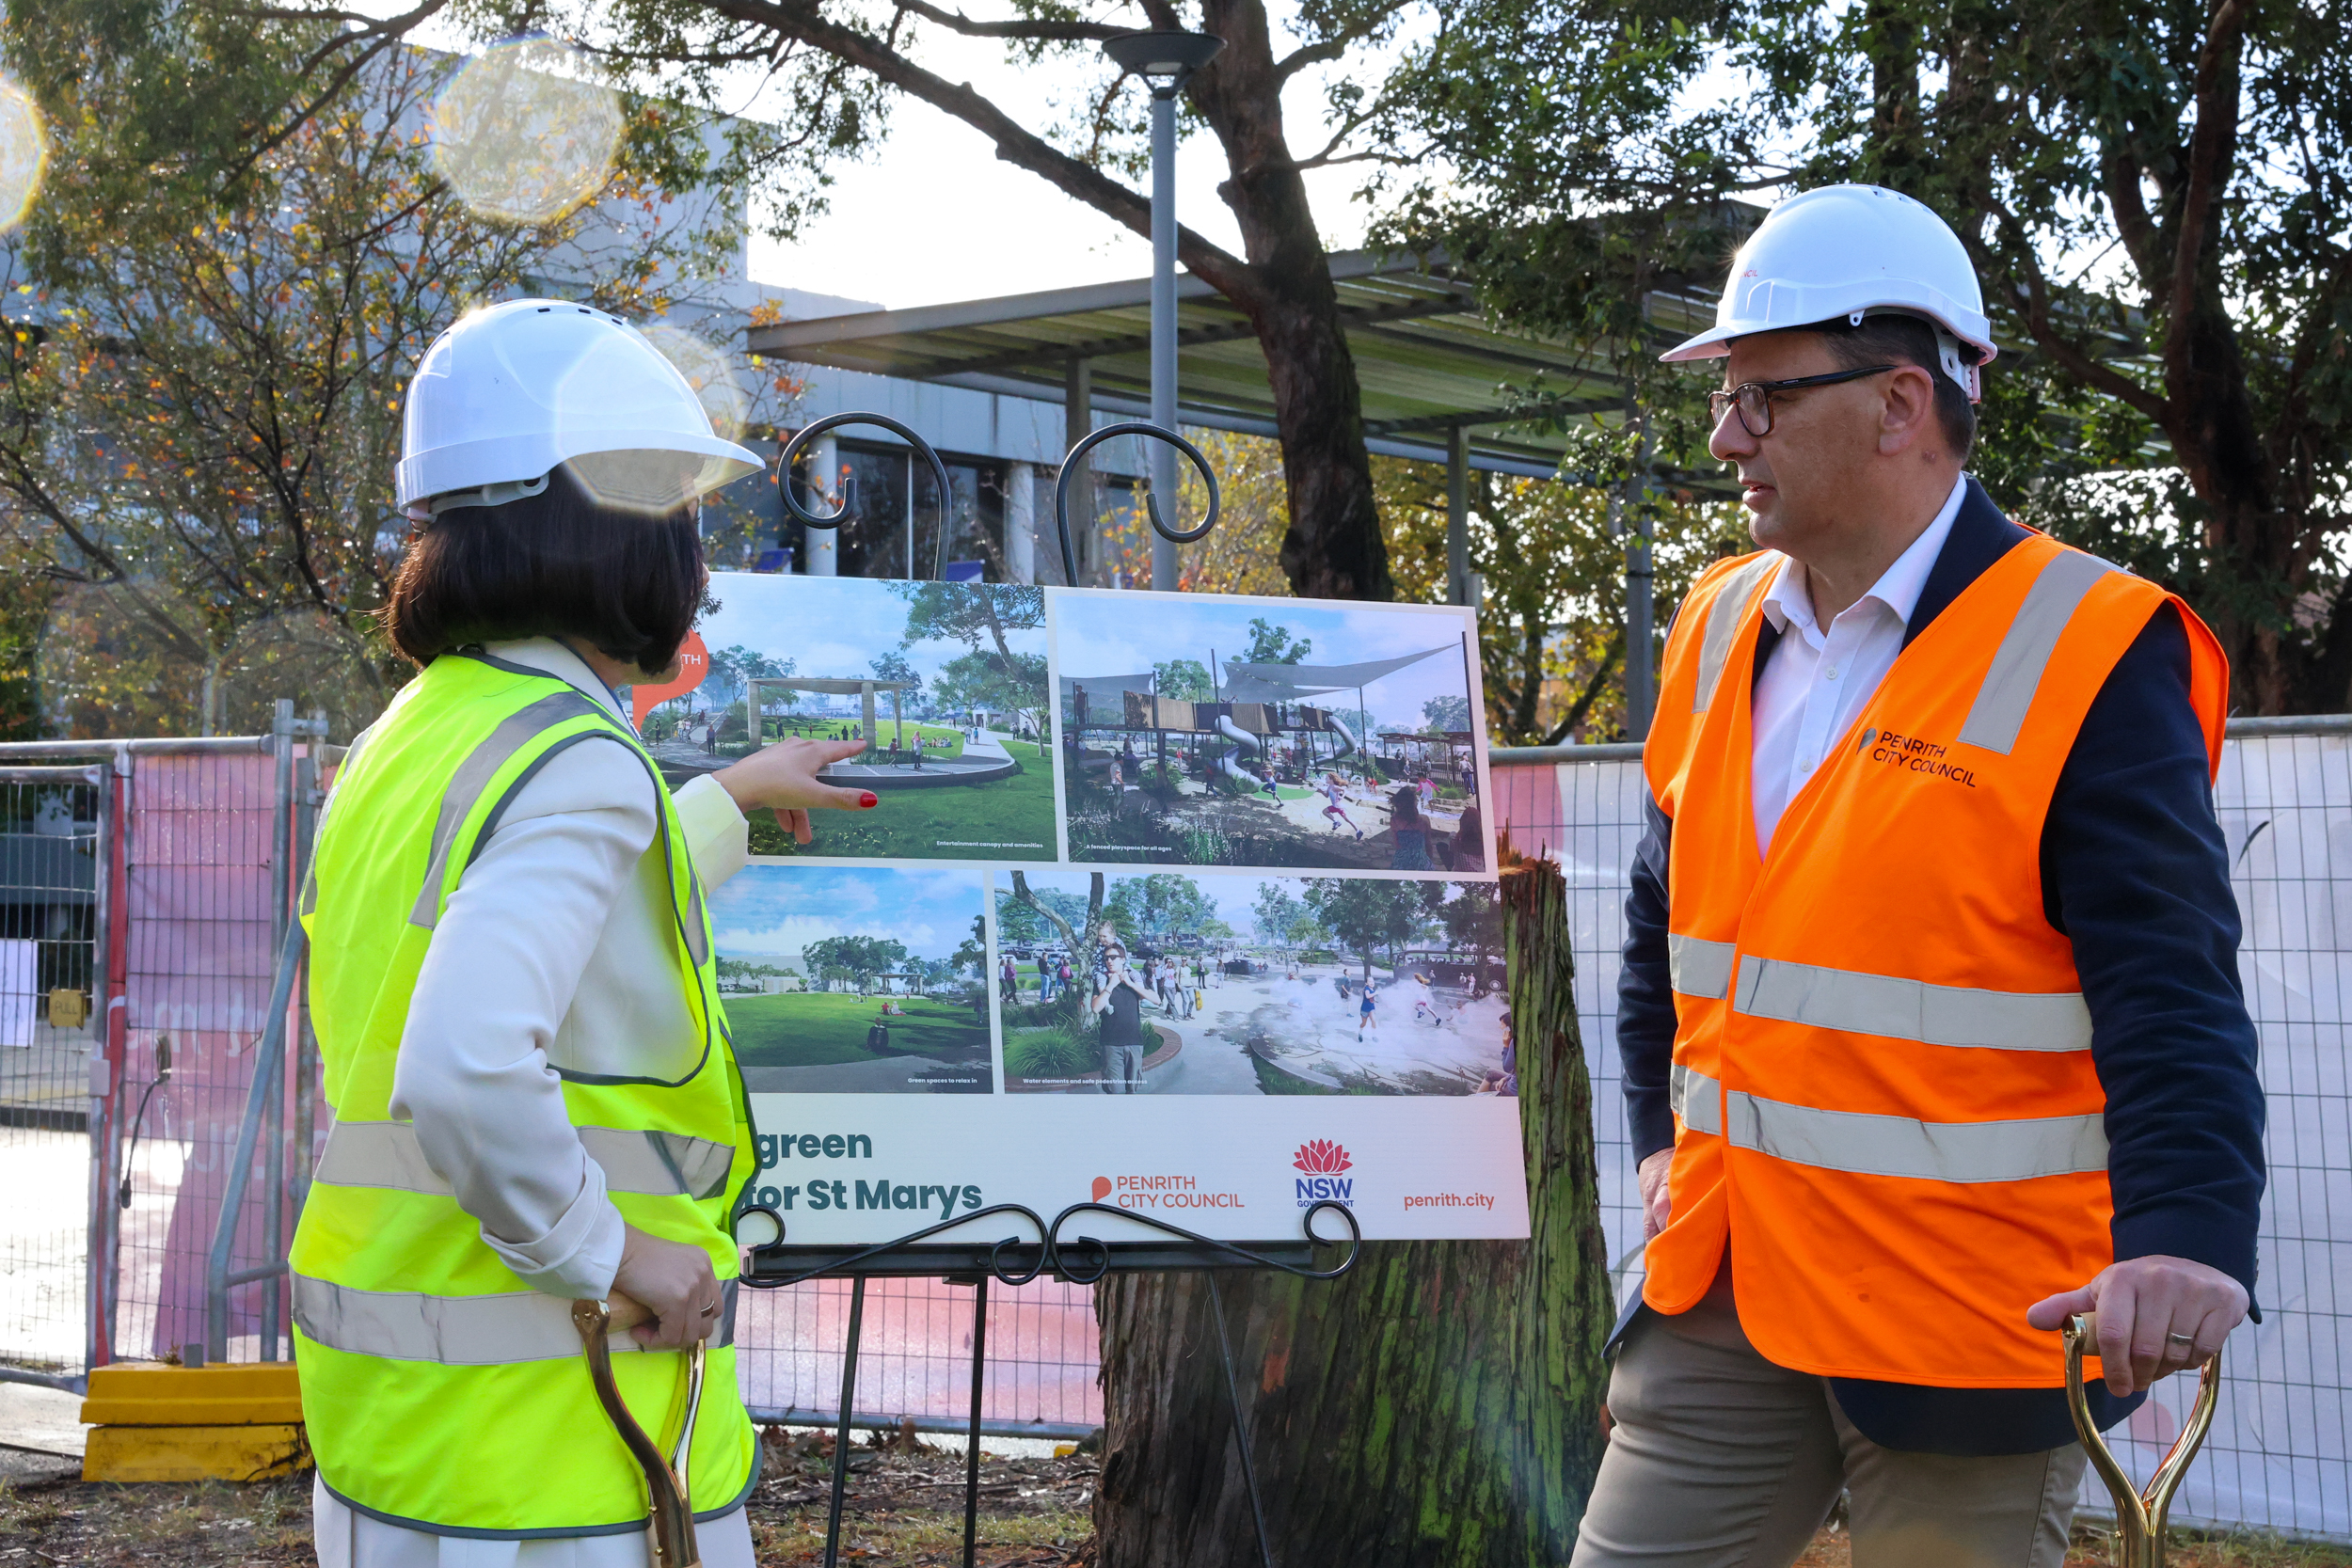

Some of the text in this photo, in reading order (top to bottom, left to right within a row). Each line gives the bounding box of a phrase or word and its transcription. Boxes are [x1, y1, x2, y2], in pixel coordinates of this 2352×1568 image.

[1880, 731, 1947, 758] PENRITH
[1873, 748, 1976, 788] CITY COUNCIL
[759, 1133, 872, 1169] green
[1117, 1176, 1196, 1190] PENRITH
[1295, 1178, 1353, 1199] NSW
[806, 1180, 847, 1210] St
[855, 1180, 982, 1220] Marys
[1118, 1194, 1245, 1208] CITY COUNCIL
[1296, 1199, 1354, 1208] GOVENT
[1404, 1193, 1495, 1211] penrith.city
